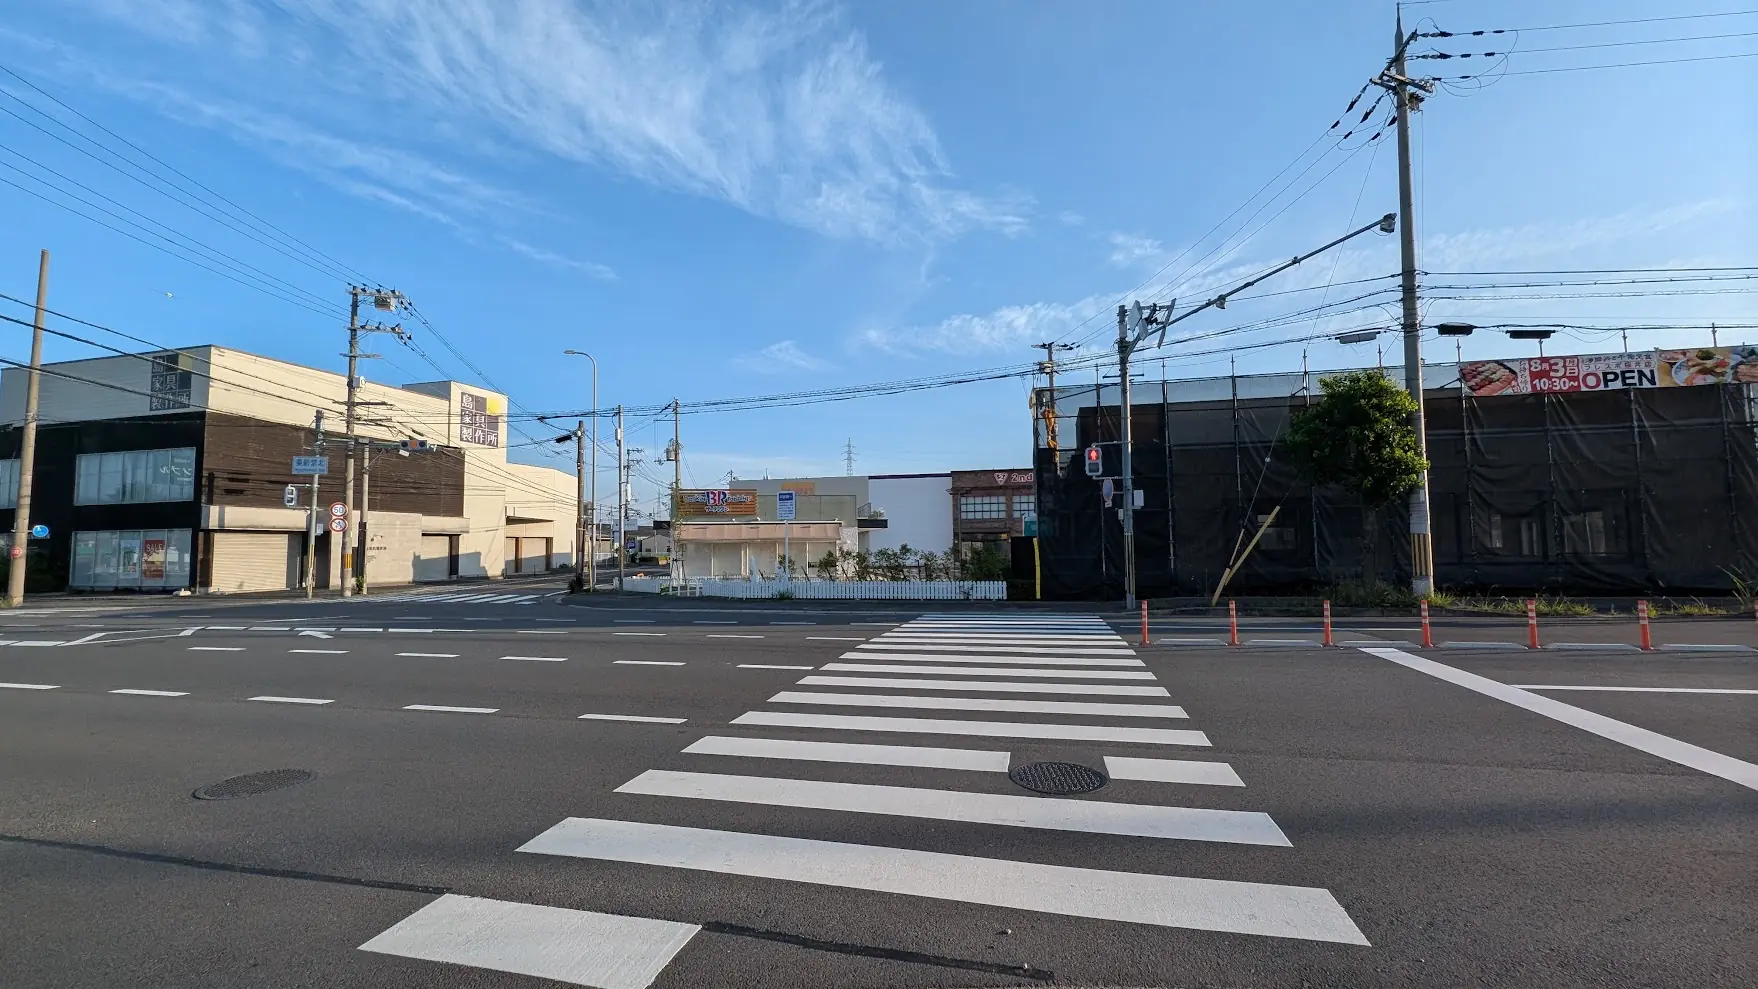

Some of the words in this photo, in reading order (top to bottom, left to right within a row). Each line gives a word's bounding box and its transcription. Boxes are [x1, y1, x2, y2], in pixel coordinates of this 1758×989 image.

[1581, 369, 1657, 390] OPEN
[461, 426, 498, 447] 製作所
[1011, 473, 1034, 482] 2nd
